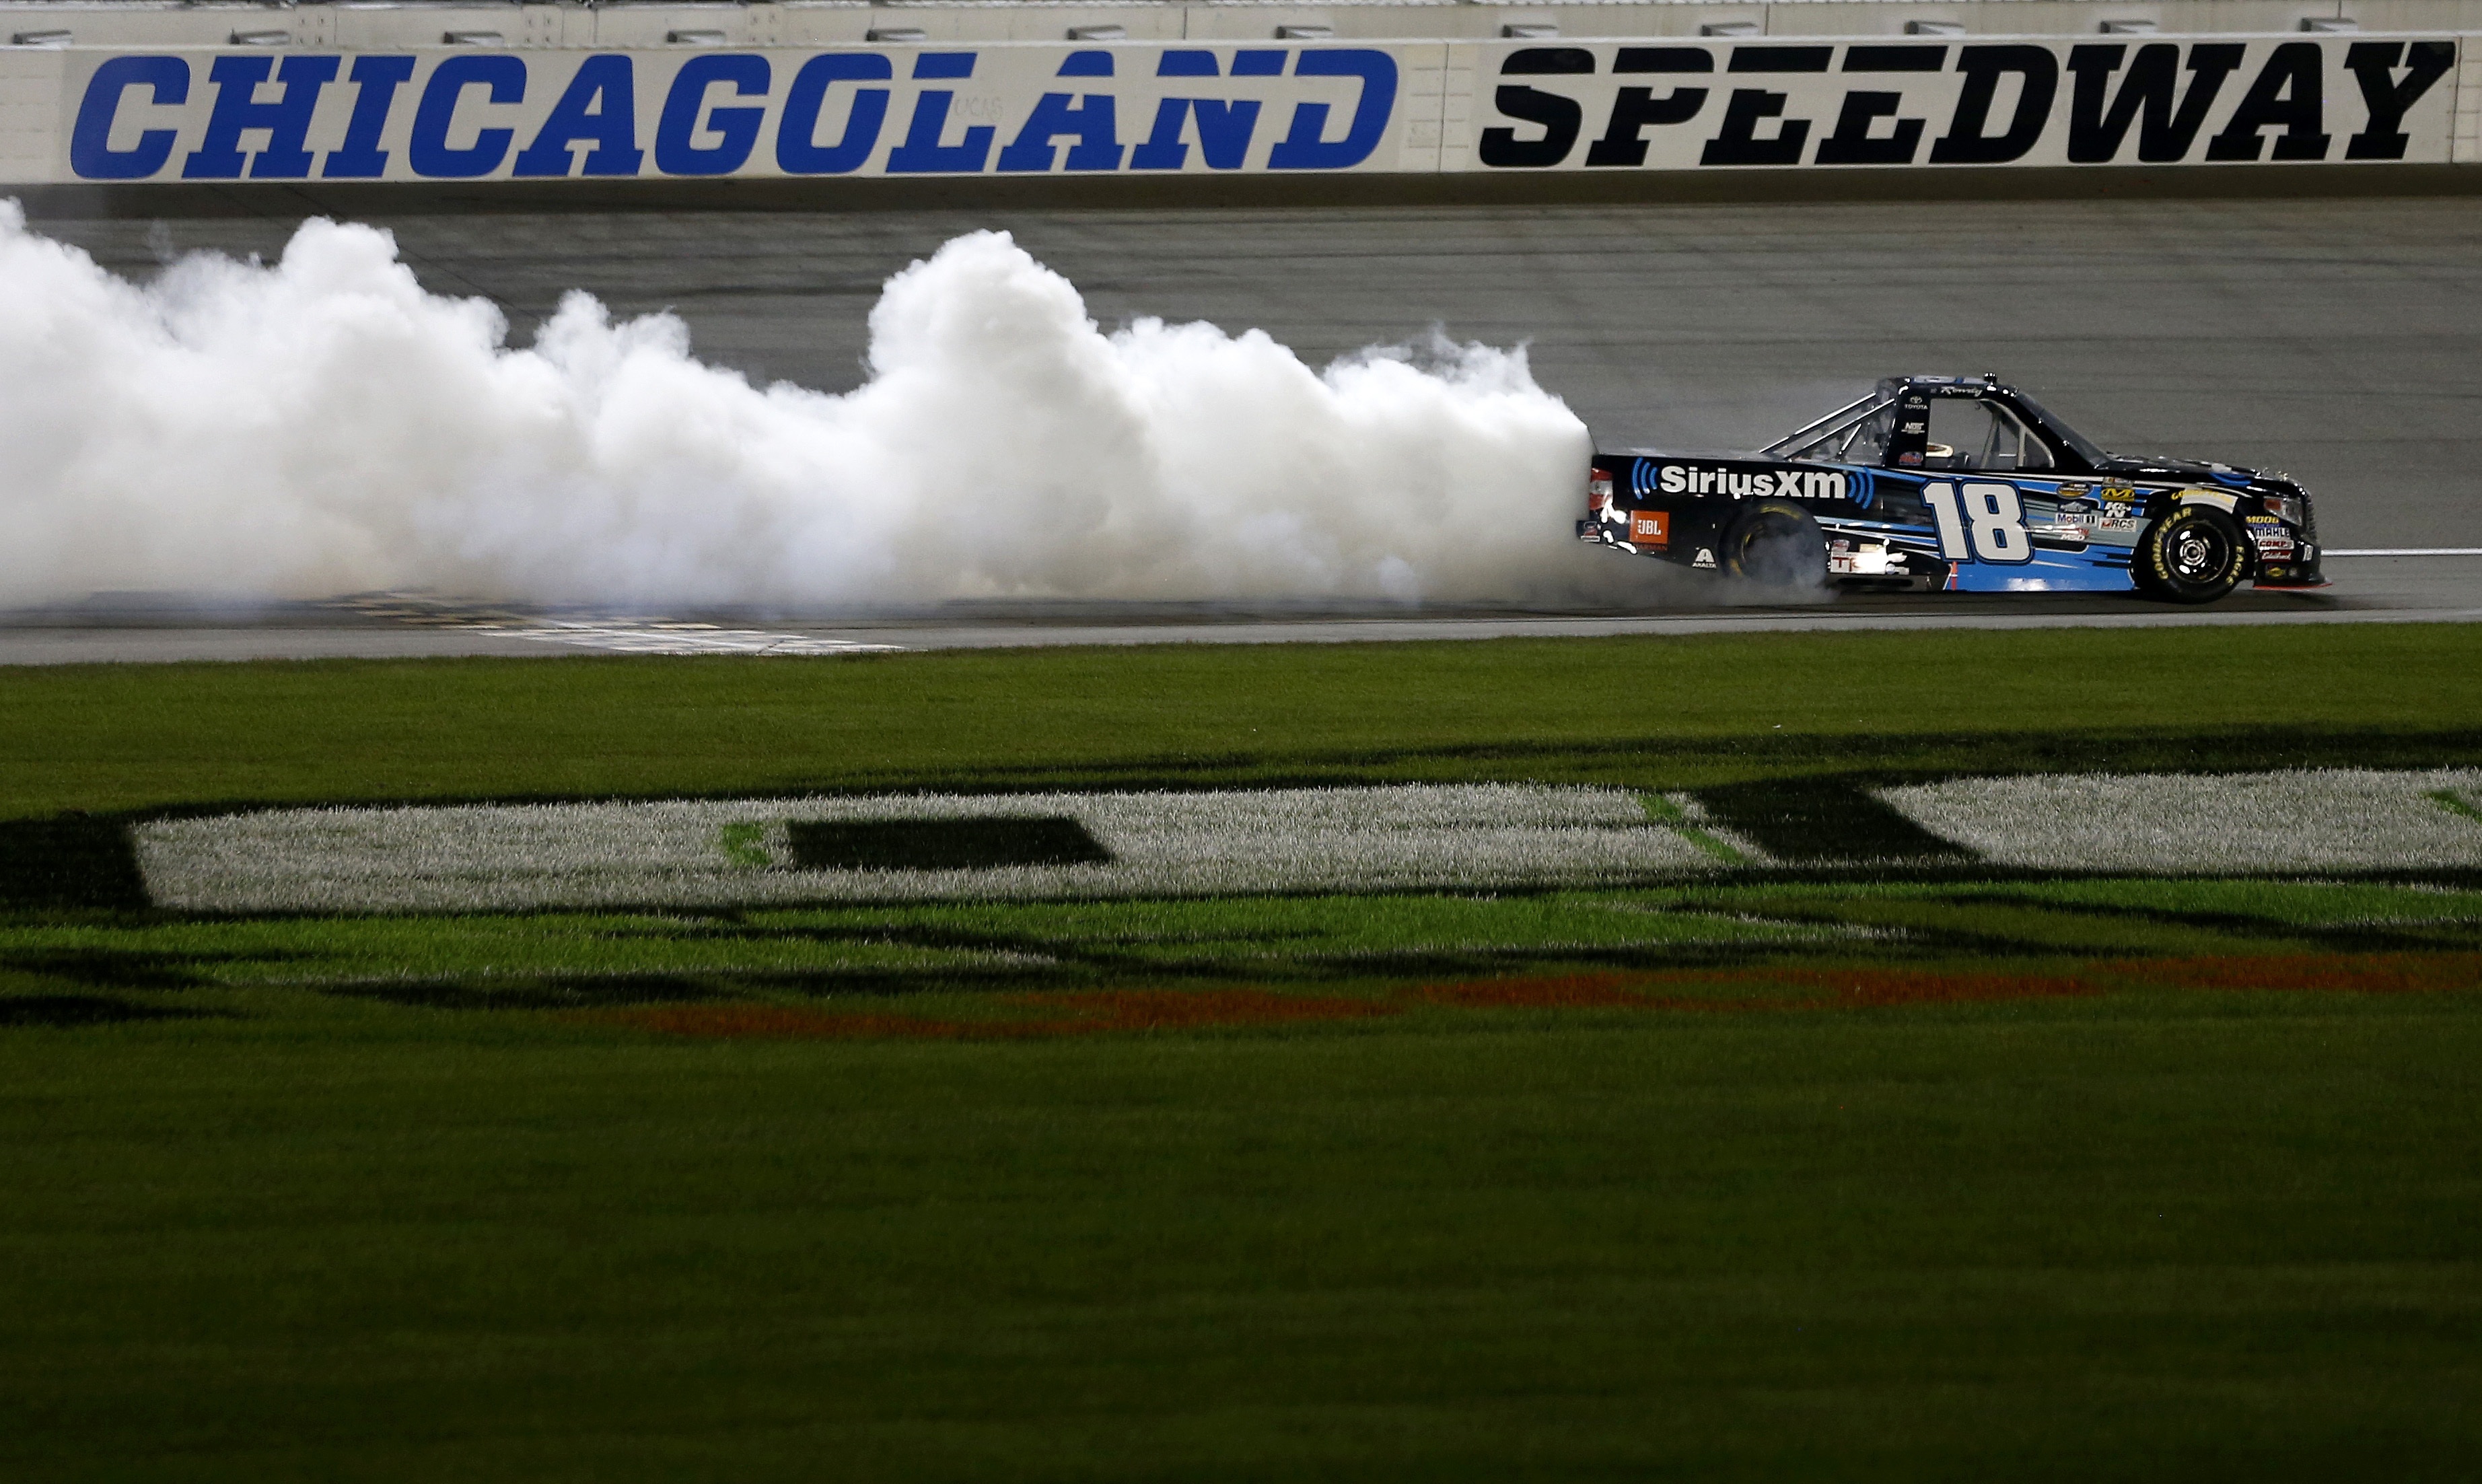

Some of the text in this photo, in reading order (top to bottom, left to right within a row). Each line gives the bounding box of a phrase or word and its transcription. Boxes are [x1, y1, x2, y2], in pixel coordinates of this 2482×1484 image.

[70, 40, 2456, 180] CHICAGOLAND SPEEDWAY
[1637, 520, 1662, 536] JBL
[1921, 479, 2033, 564] 18
[2057, 514, 2084, 524] Mobil
